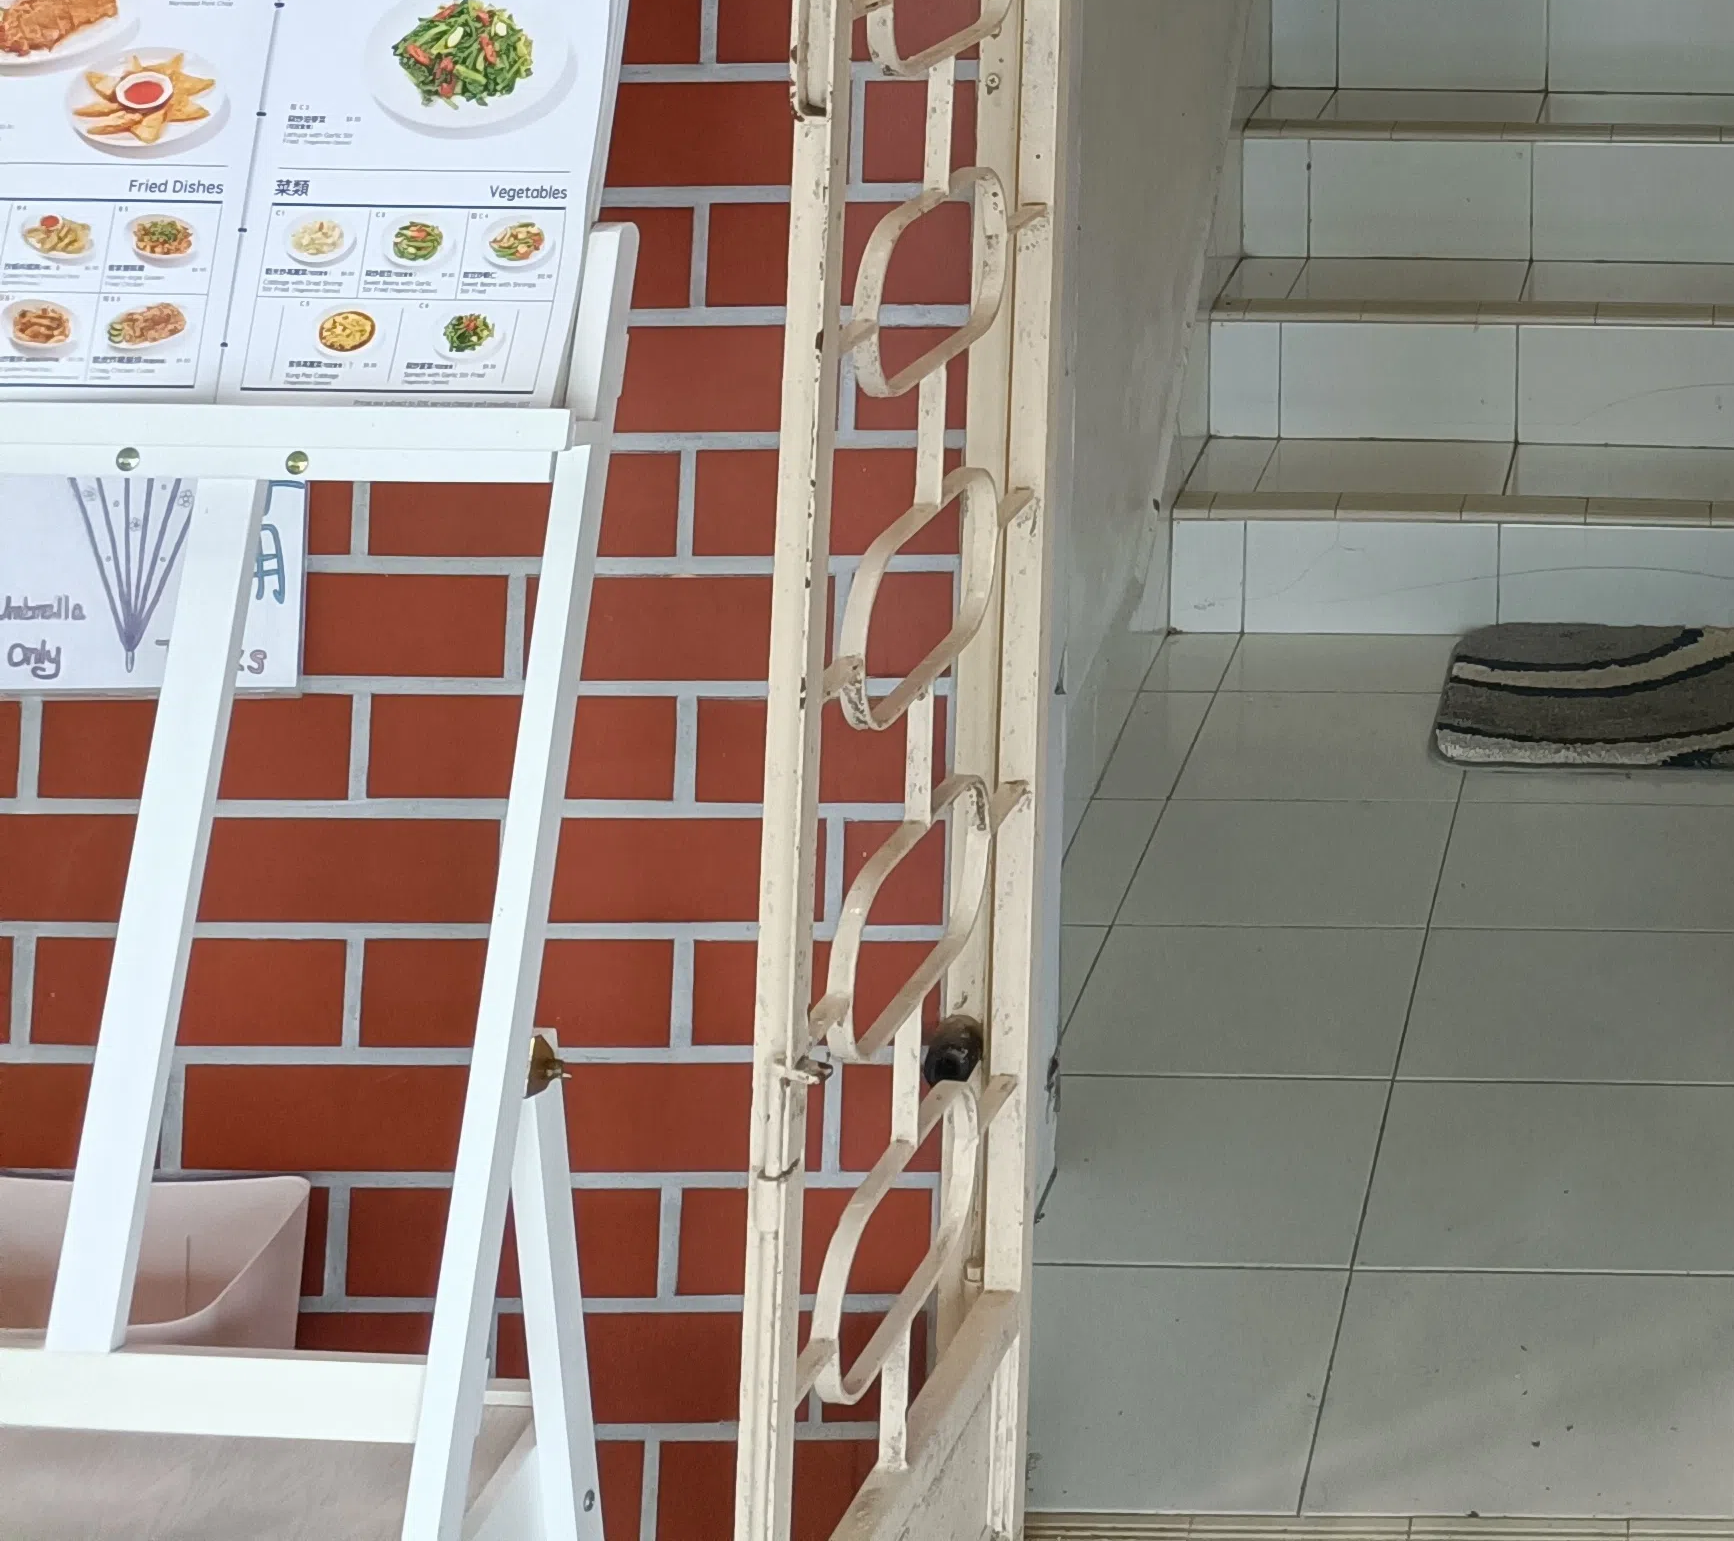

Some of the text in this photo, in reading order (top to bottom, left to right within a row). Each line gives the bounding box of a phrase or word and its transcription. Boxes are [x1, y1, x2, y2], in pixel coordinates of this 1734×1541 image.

[128, 179, 224, 195] Fried Dishes
[489, 184, 568, 201] Vegetables
[7, 638, 62, 680] Only
